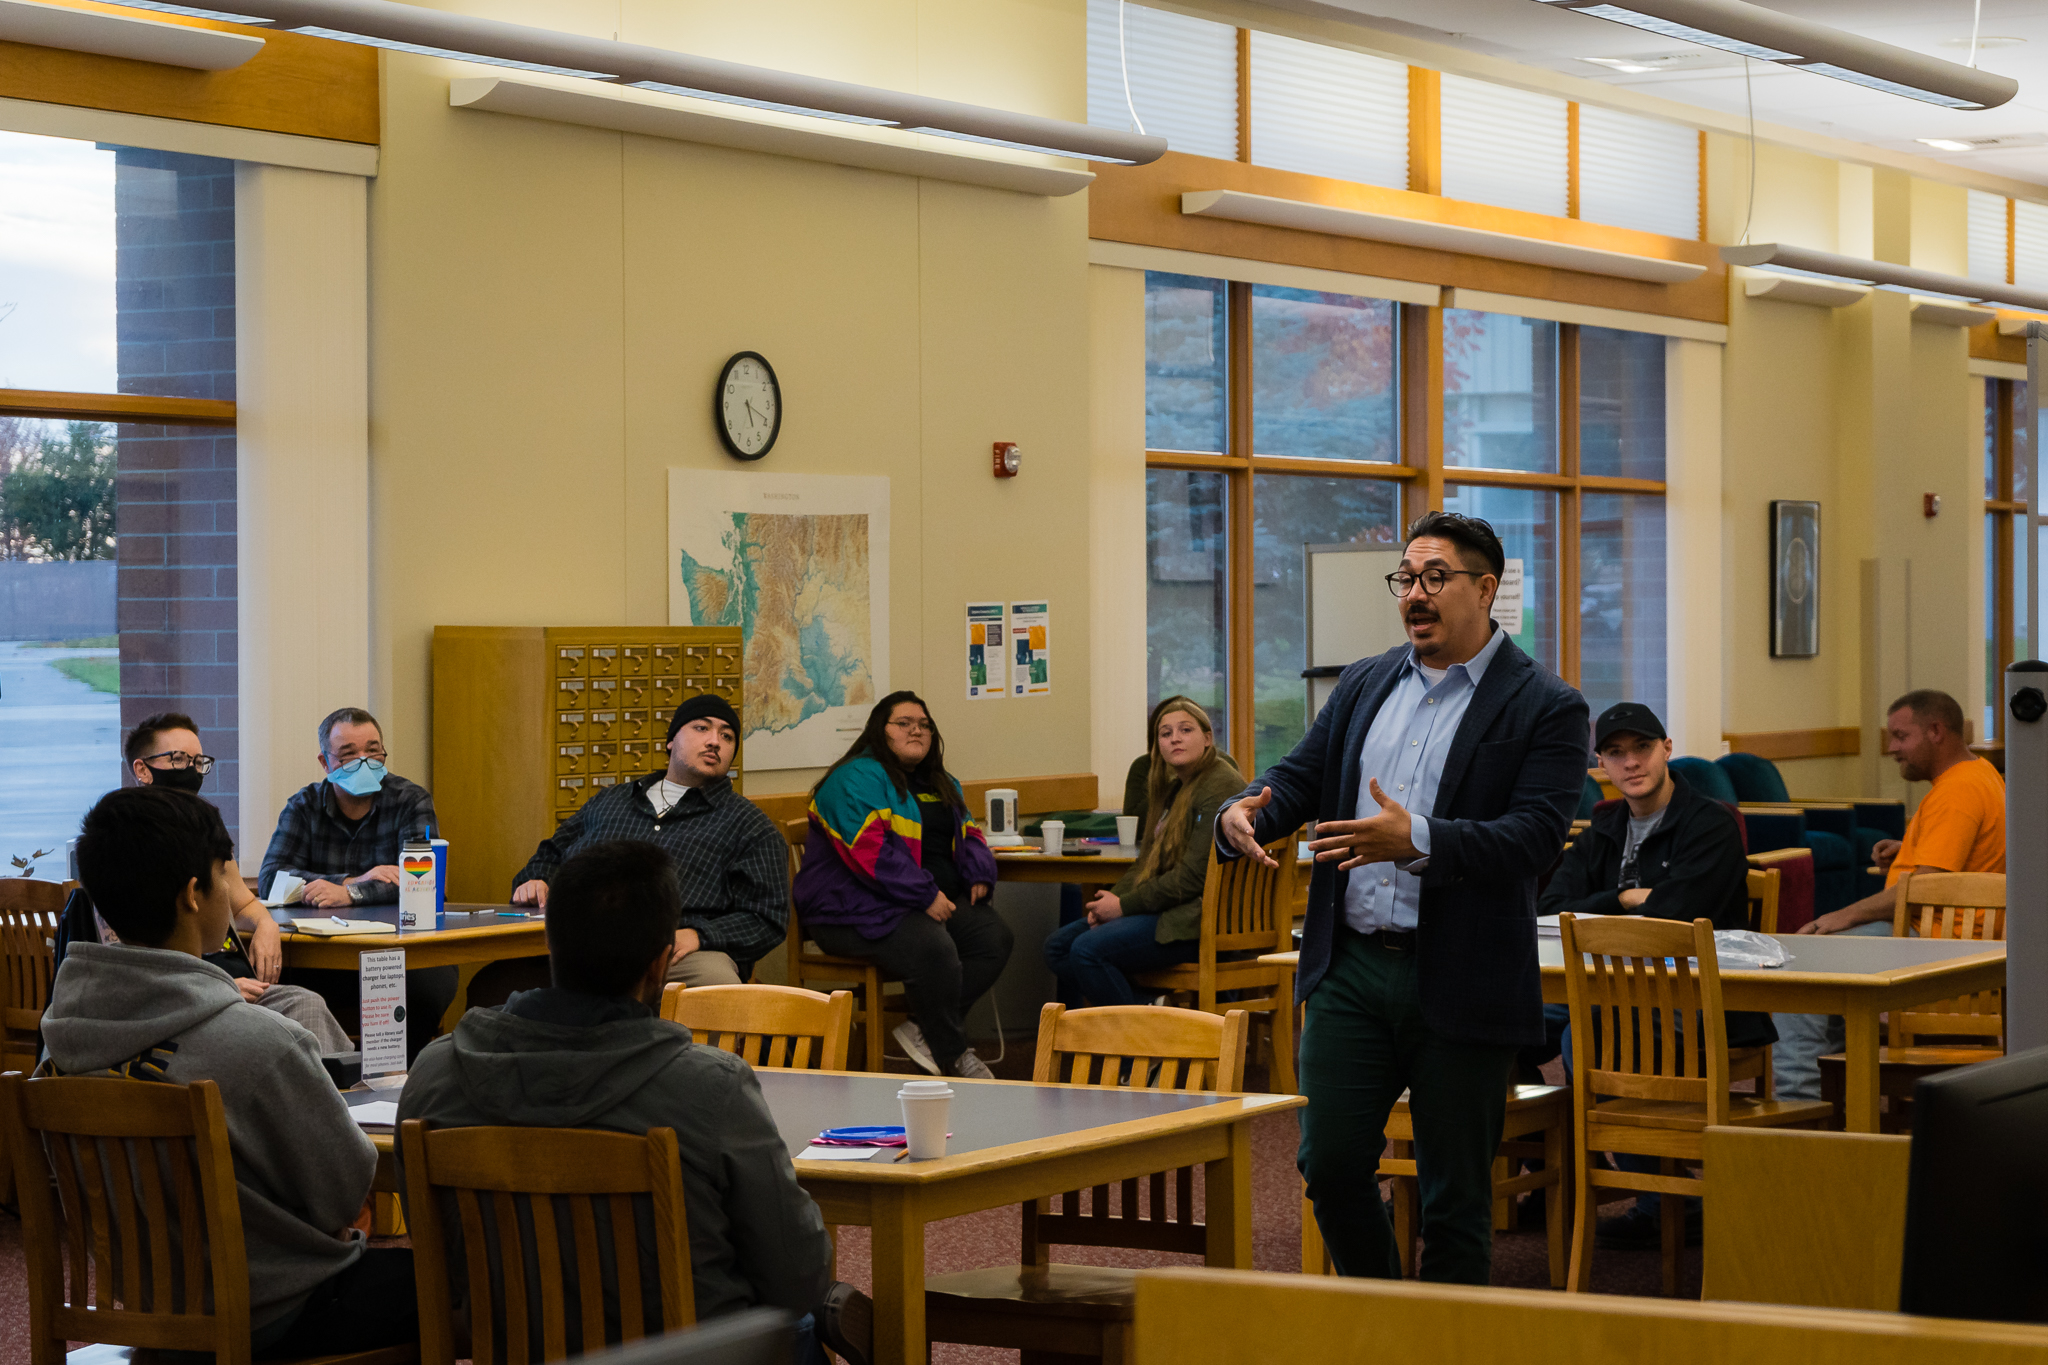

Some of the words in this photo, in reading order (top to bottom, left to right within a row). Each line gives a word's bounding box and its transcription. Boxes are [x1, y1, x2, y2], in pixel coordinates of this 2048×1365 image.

[743, 364, 750, 374] 12
[726, 384, 735, 394] 10
[762, 381, 766, 391] 2
[725, 402, 729, 411] 9
[766, 400, 770, 410] 3
[728, 420, 732, 430] 8
[763, 418, 768, 427] 4
[738, 432, 741, 442] 7
[757, 431, 761, 442] 5
[746, 437, 751, 447] 6
